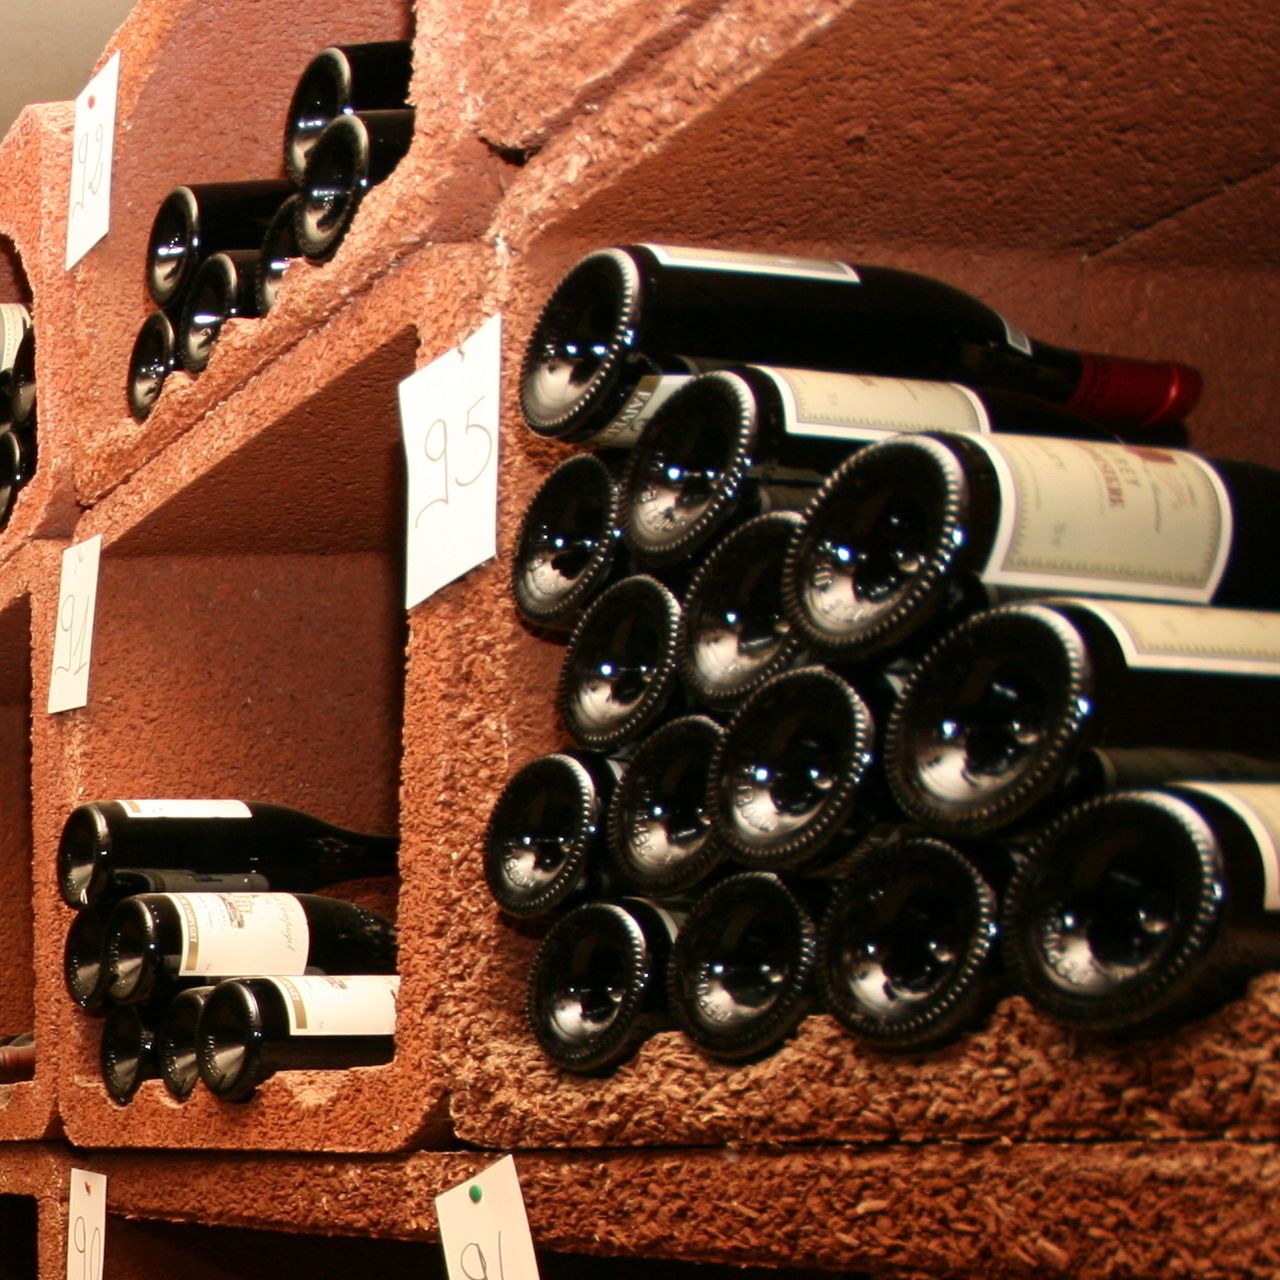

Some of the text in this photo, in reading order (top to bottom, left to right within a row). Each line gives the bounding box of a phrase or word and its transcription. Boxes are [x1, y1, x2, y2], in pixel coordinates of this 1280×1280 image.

[72, 124, 104, 218] 92
[415, 395, 492, 529] 95
[54, 594, 90, 676] 91
